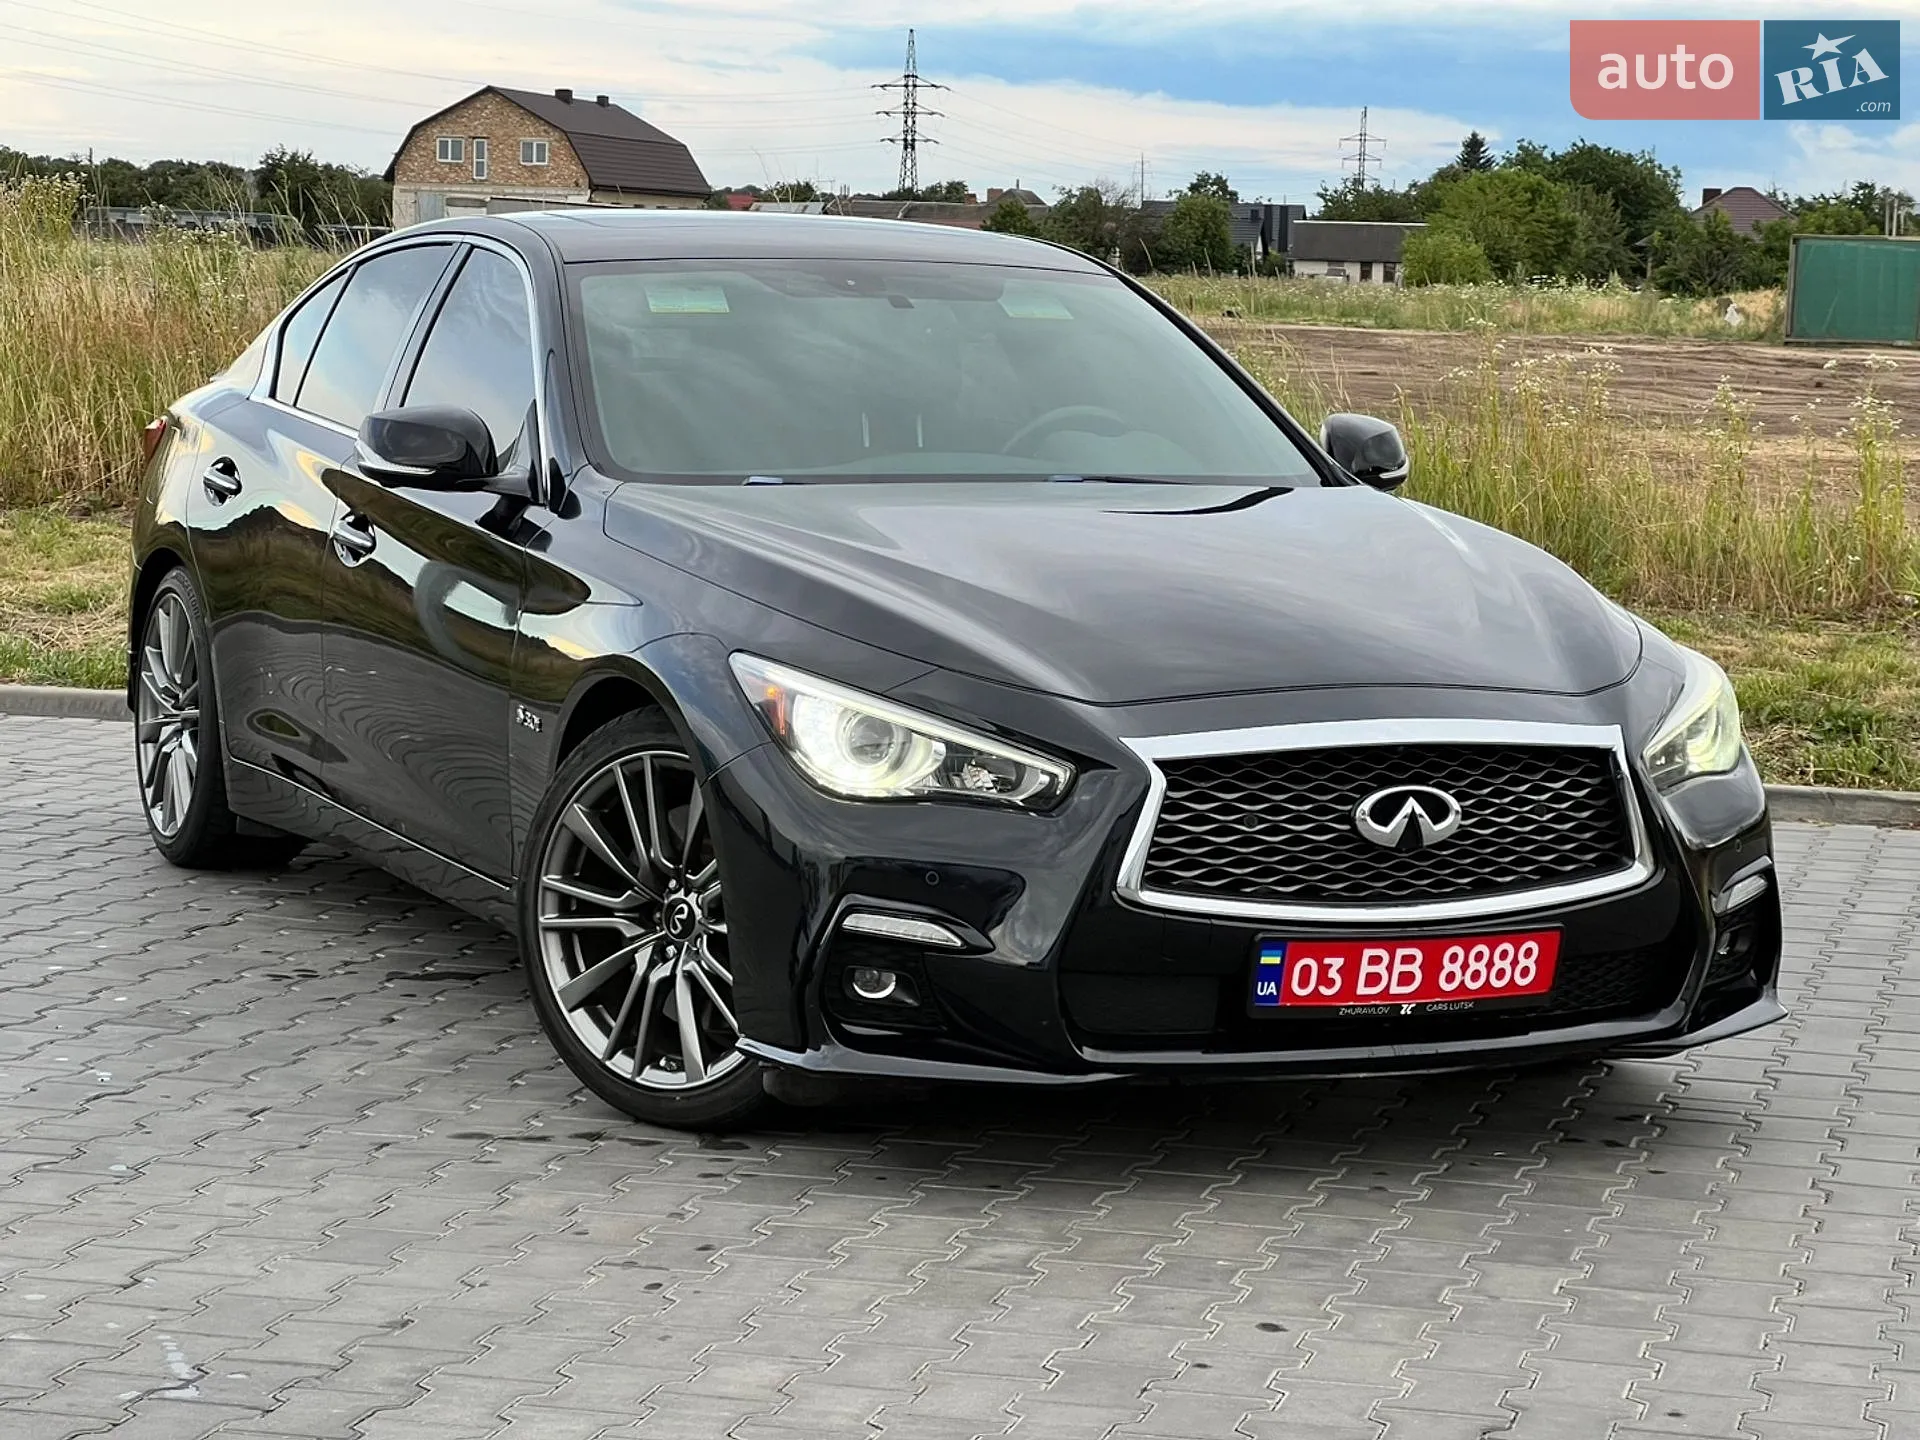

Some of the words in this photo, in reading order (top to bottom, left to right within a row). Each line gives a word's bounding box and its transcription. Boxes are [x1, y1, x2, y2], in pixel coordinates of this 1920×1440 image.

[1291, 957, 1344, 997] 03
[1356, 948, 1423, 995] BB
[1438, 940, 1539, 992] 8888
[1257, 981, 1277, 996] UA
[1339, 1006, 1390, 1016] ZHURAVLOV
[1426, 1003, 1448, 1012] CARS
[1449, 1001, 1475, 1011] LUTSK
